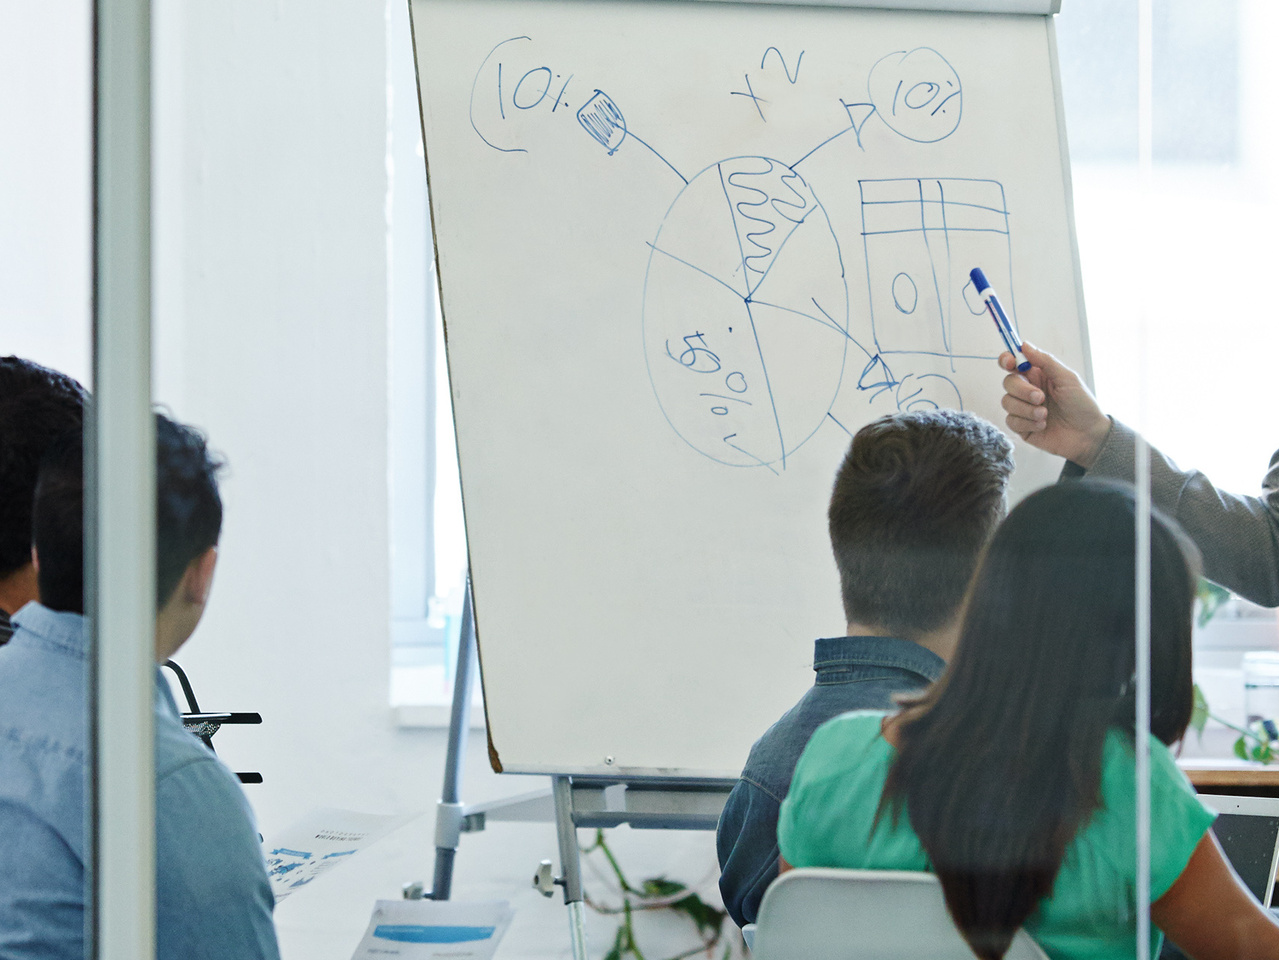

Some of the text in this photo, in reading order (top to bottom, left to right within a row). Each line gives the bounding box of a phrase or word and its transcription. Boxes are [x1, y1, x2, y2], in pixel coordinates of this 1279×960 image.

[498, 62, 574, 120] 10%
[892, 79, 962, 117] 10%
[665, 330, 753, 416] 50%
